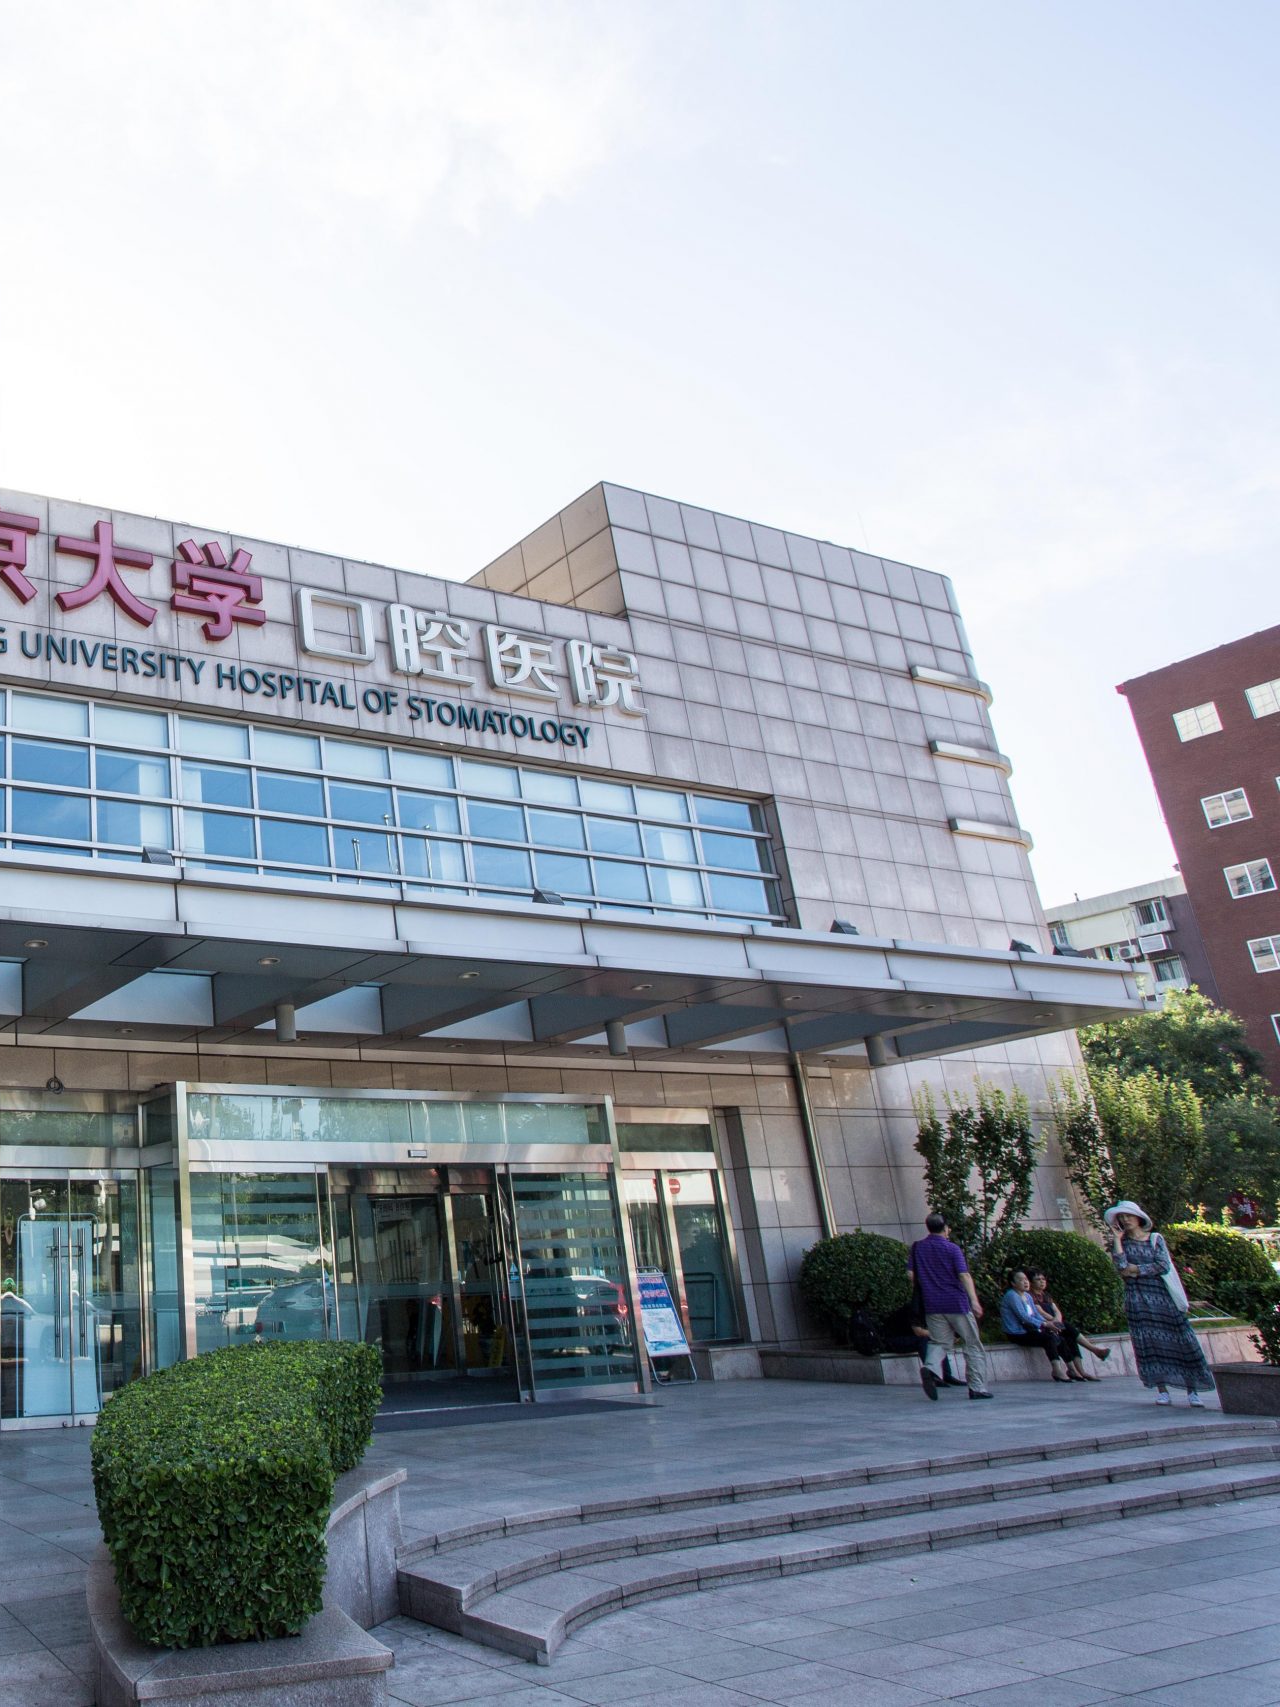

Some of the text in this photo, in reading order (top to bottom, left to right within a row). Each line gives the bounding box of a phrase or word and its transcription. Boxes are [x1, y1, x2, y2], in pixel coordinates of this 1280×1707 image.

[21, 632, 204, 685] UNIVERSITY
[217, 663, 355, 710] HOSPITAL
[366, 688, 398, 715] OF
[408, 696, 591, 749] STOMATOLOGY
[298, 587, 649, 715] 口腔医院
